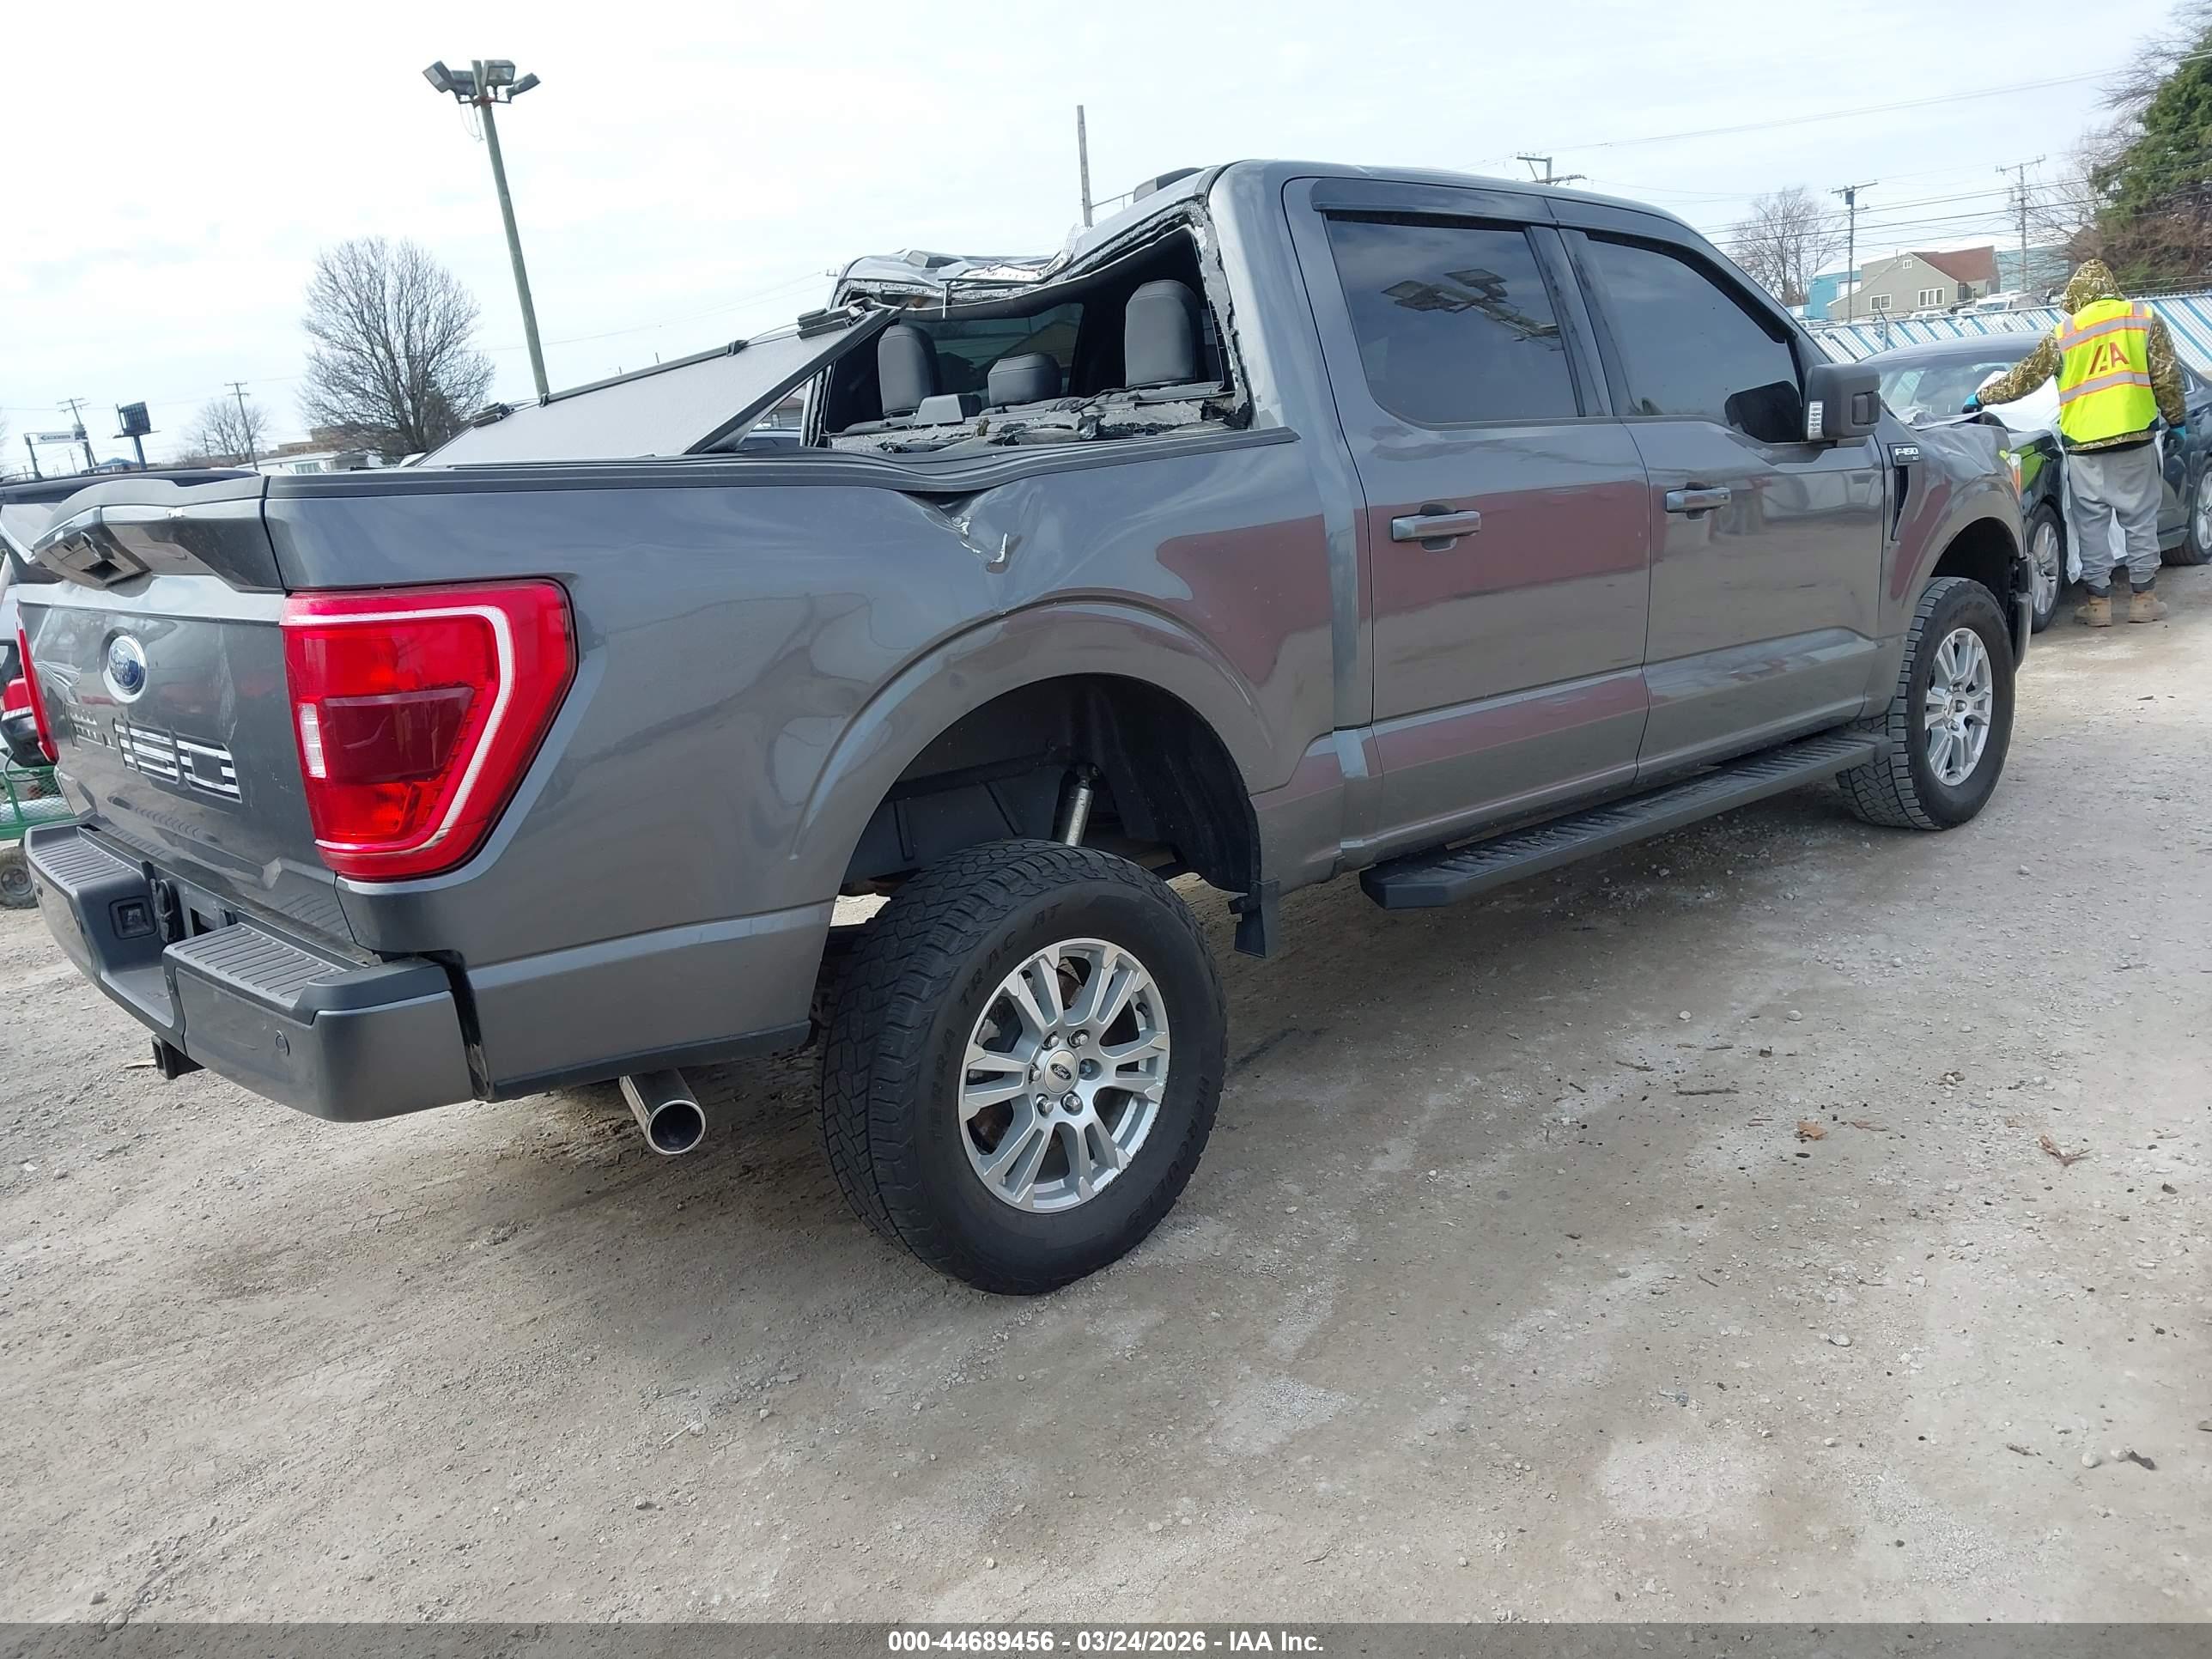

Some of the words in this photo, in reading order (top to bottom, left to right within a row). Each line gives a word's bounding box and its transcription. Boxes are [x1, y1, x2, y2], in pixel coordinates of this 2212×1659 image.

[1894, 447, 1919, 456] F-150
[959, 930, 1017, 1007] TRAC
[1052, 1064, 1071, 1079] Ford
